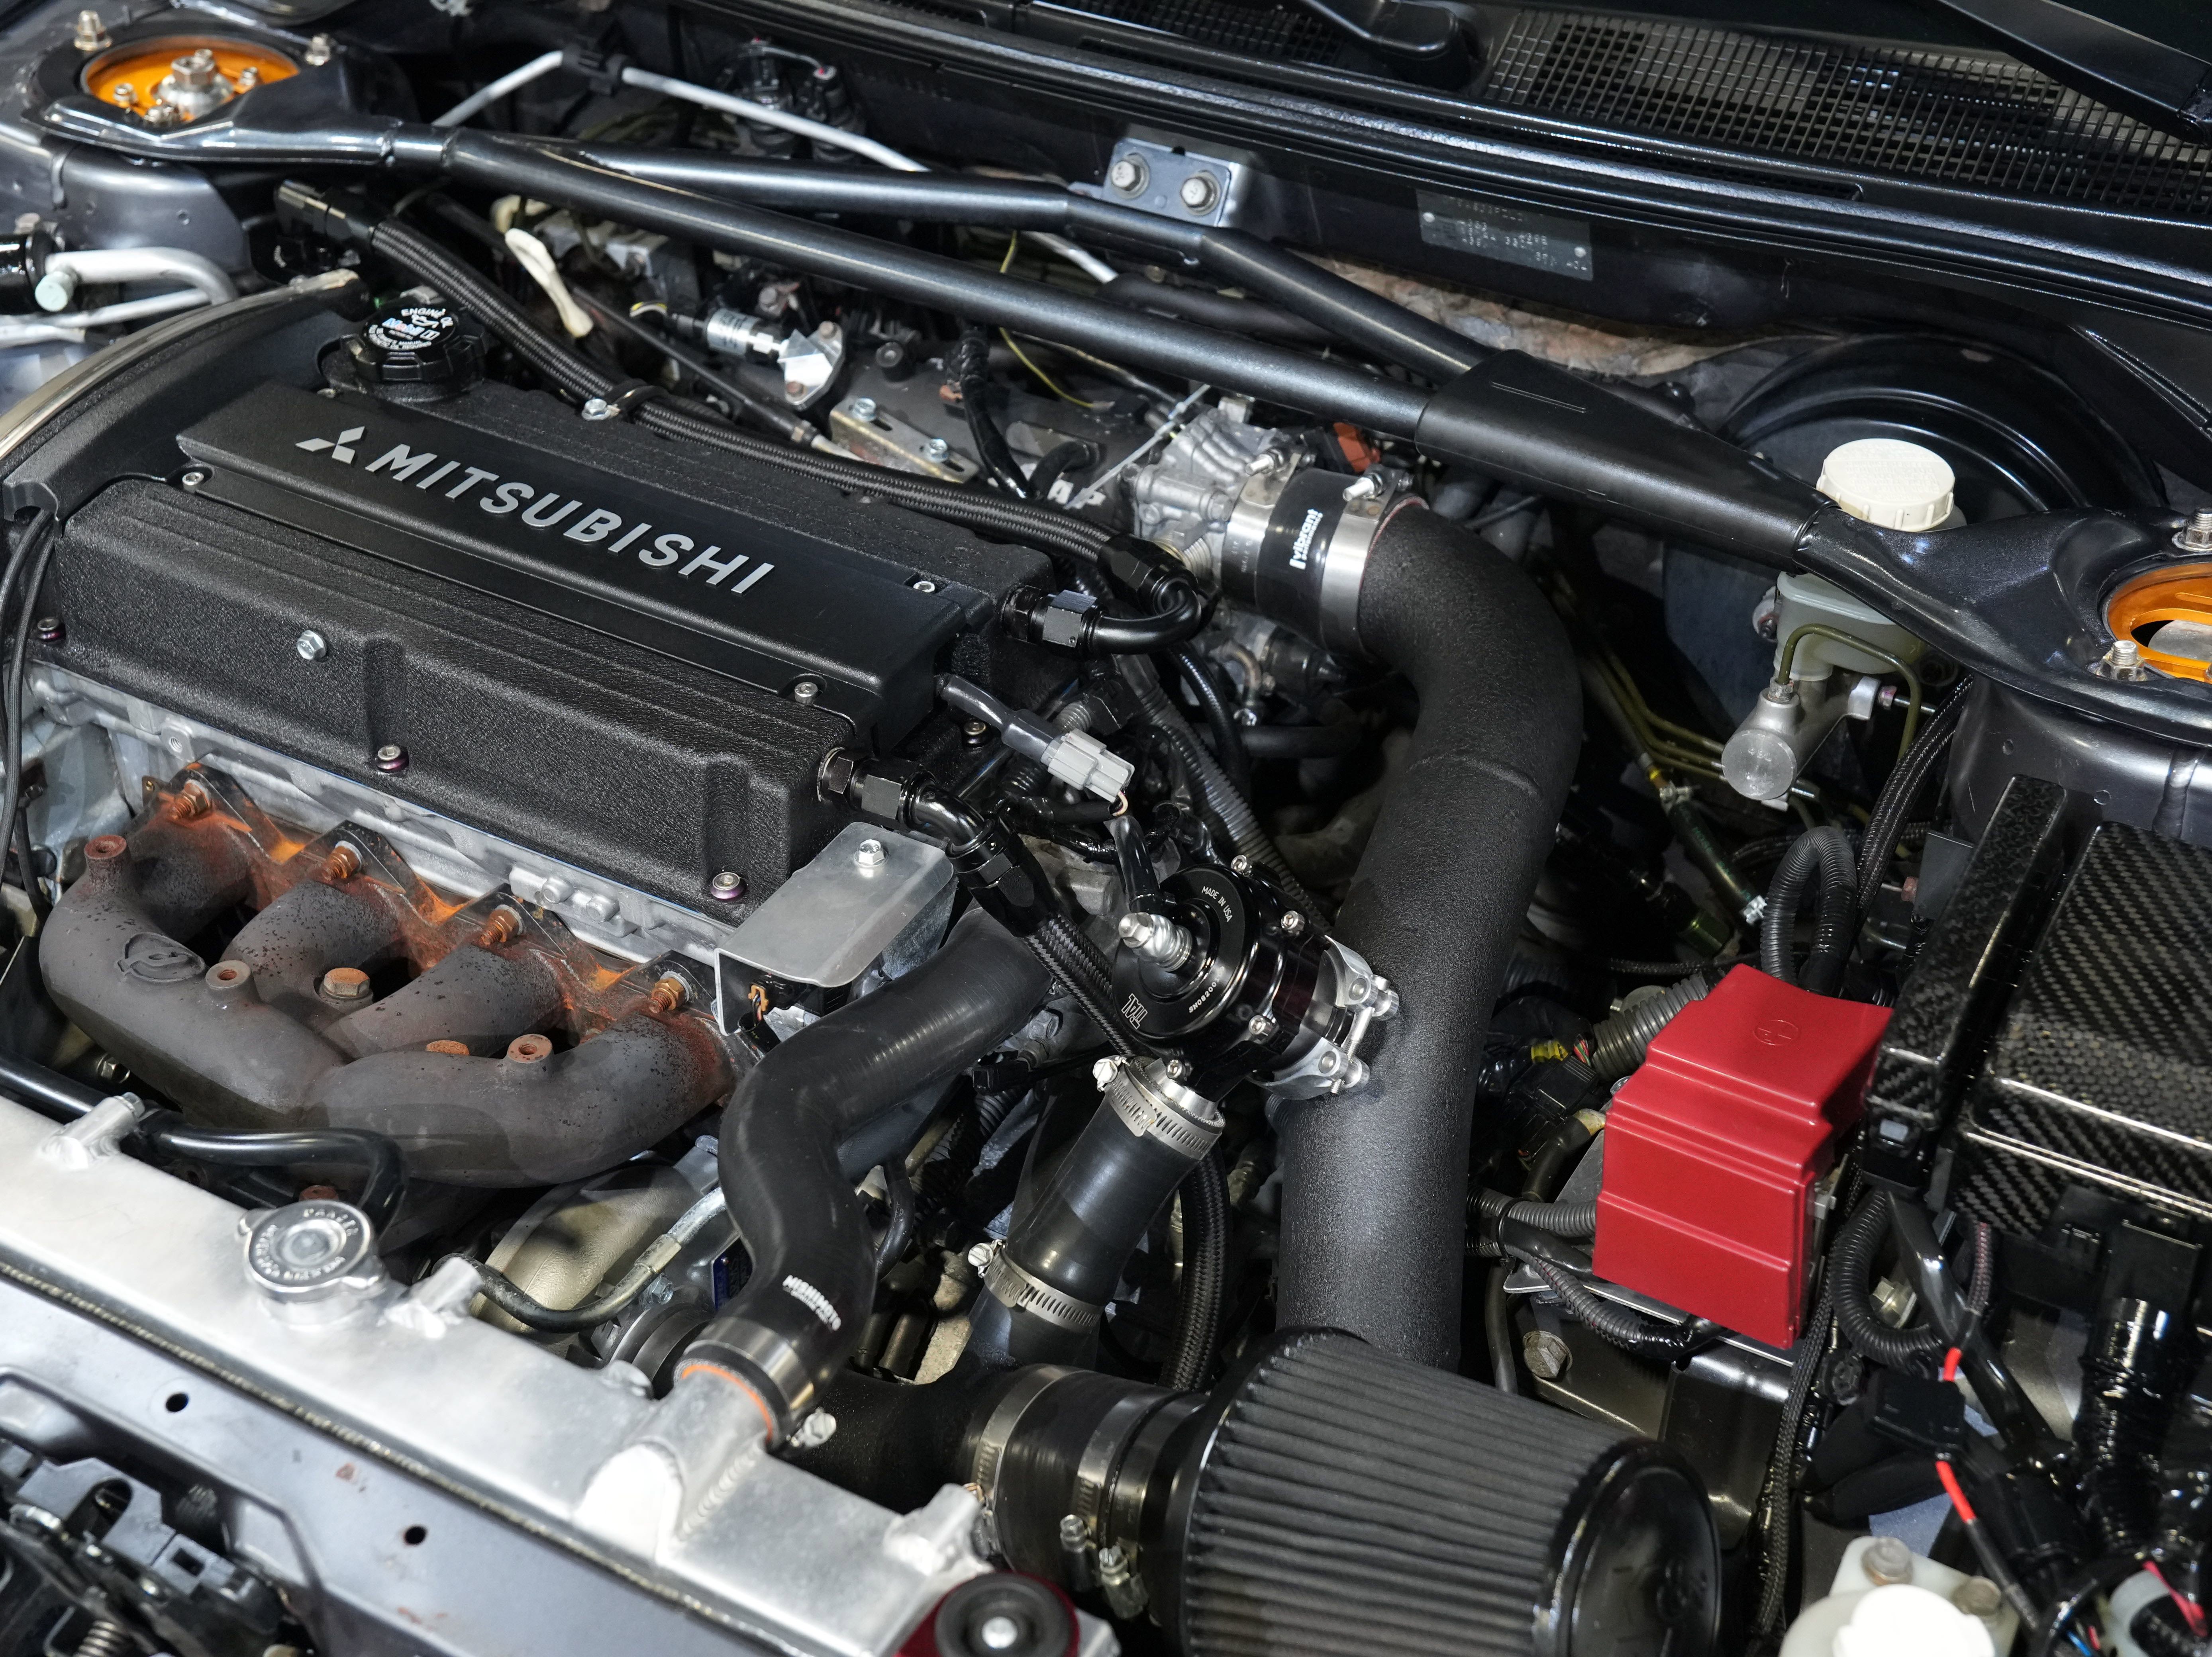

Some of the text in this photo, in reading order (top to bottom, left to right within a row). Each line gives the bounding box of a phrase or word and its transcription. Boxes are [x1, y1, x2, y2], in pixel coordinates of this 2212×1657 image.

[401, 308, 453, 329] ENGINE OIL
[365, 443, 775, 595] MITSUBISHI
[1292, 508, 1319, 560] vibrant
[1201, 886, 1233, 923] MADE IN USA
[782, 1275, 841, 1331] MISHIMOTO
